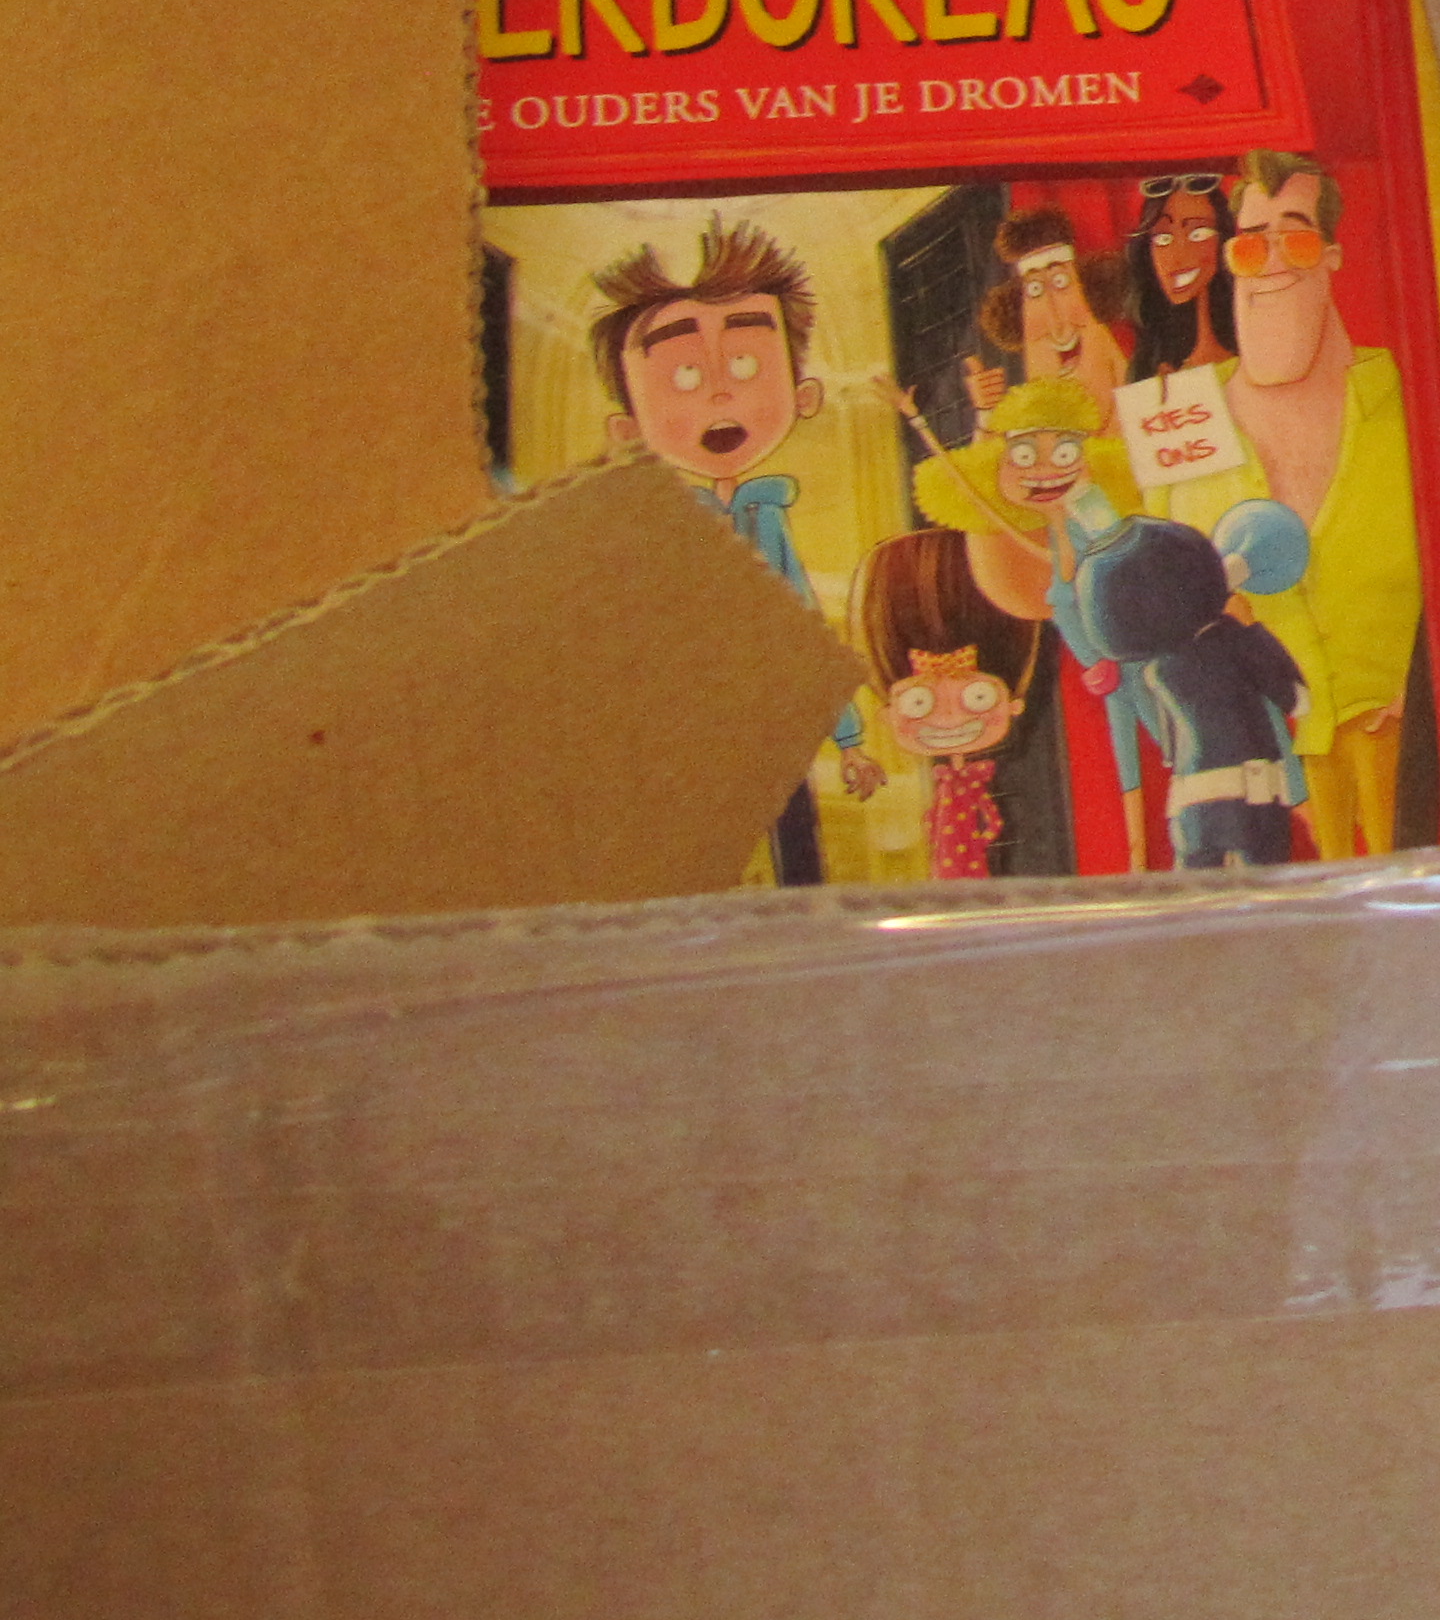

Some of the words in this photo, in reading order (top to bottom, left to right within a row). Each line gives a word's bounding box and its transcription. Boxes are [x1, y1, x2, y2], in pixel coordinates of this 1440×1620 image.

[511, 91, 720, 130] OUDERS
[737, 84, 838, 121] VAN
[851, 81, 904, 124] JE
[919, 72, 1142, 114] DROMEN
